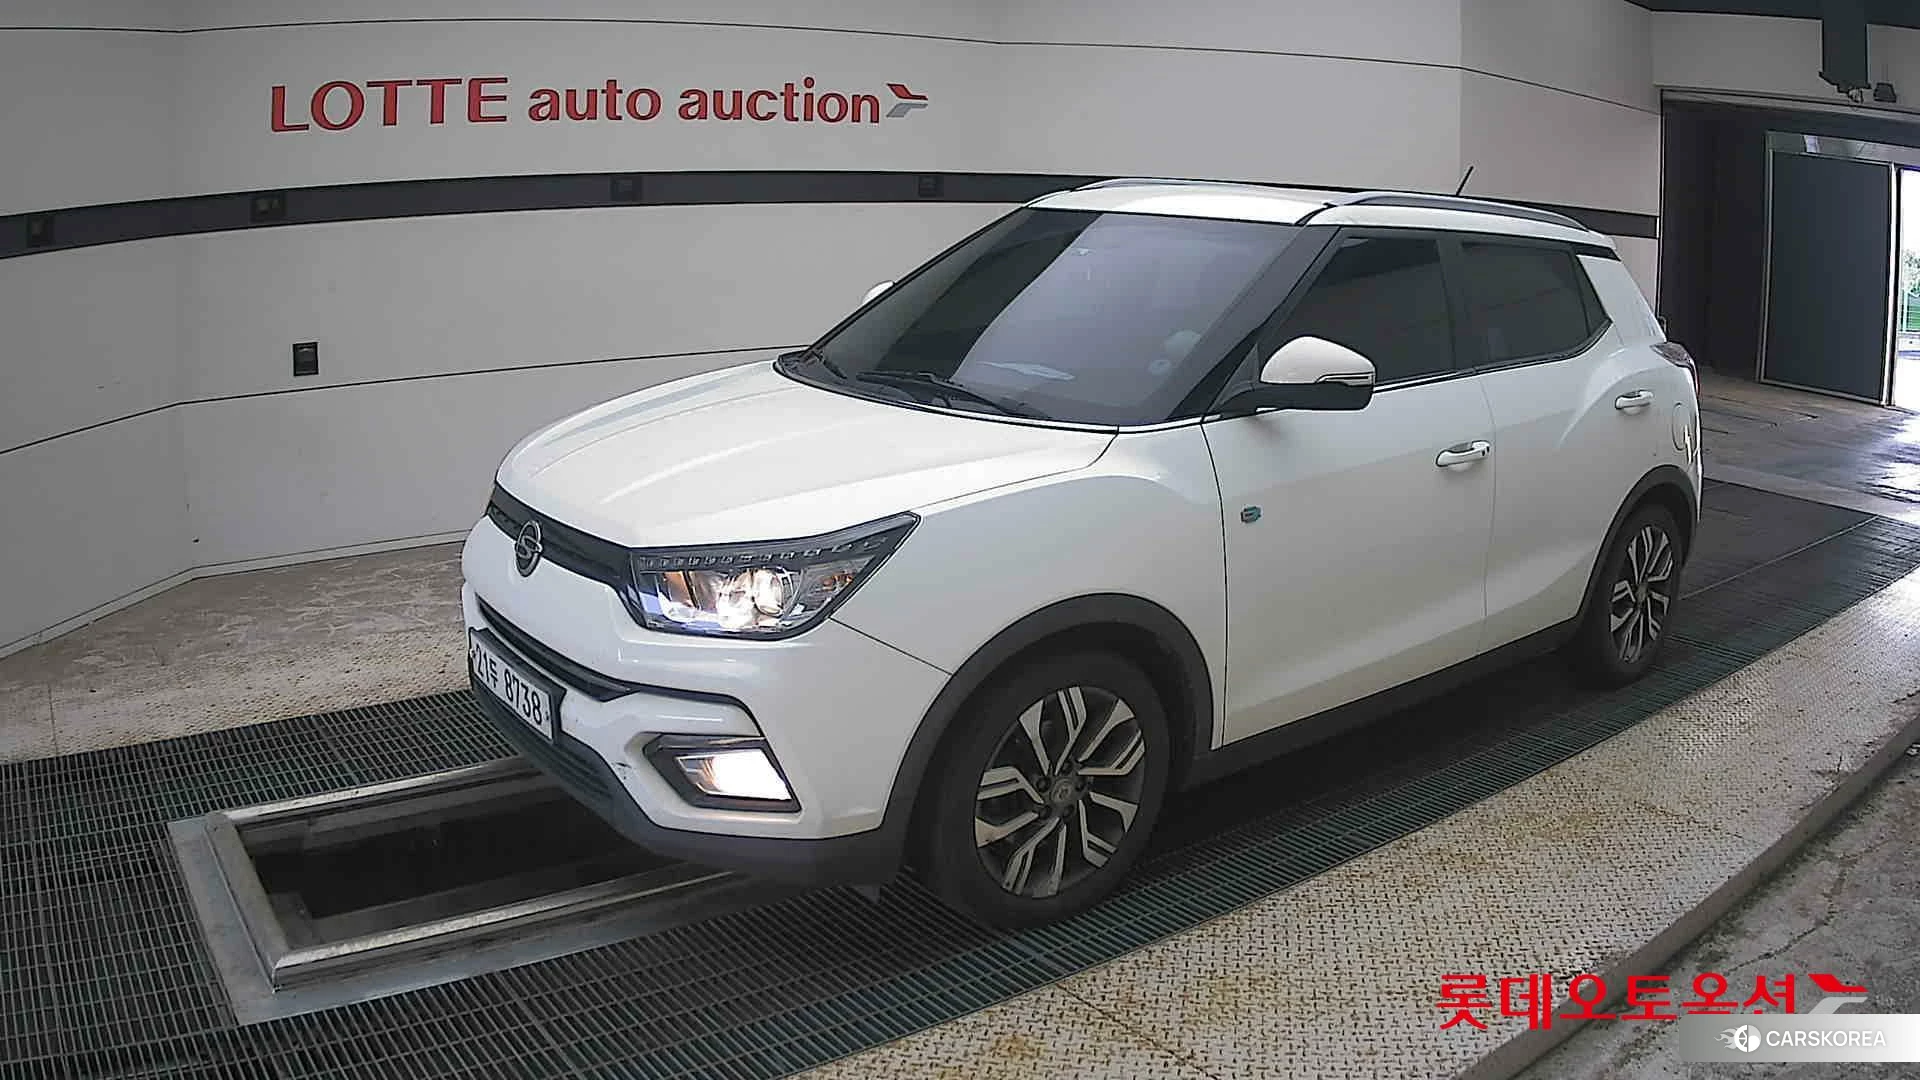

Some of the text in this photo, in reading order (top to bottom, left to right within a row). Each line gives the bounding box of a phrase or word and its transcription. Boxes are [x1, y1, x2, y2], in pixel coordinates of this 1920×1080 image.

[270, 76, 881, 133] LOTTE auto auction
[504, 668, 543, 726] 8738
